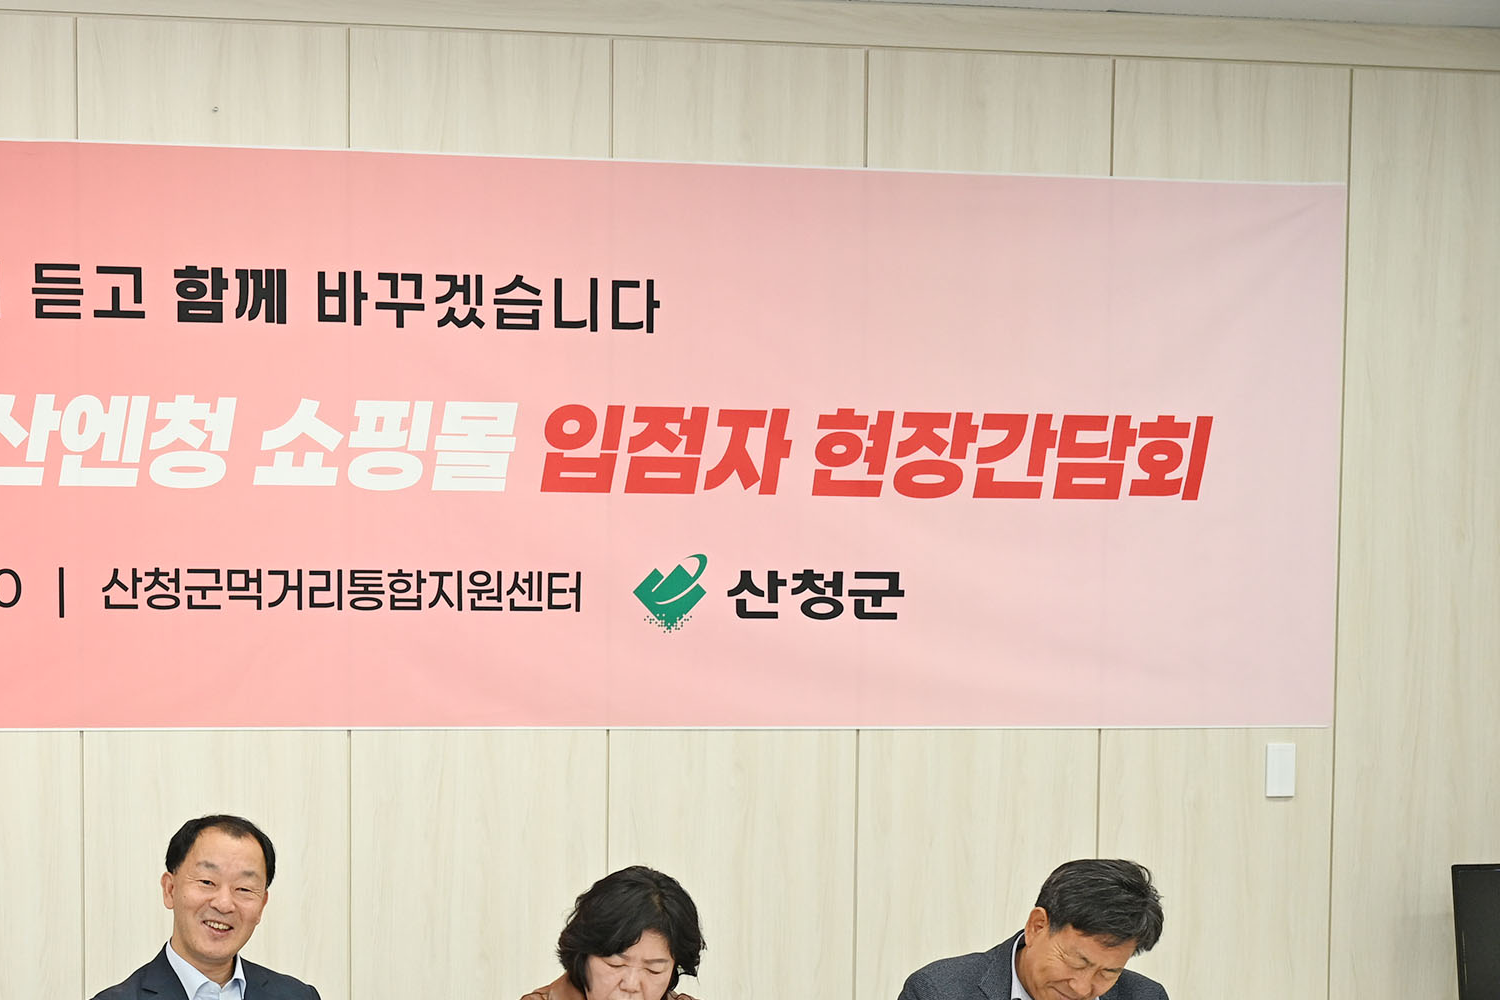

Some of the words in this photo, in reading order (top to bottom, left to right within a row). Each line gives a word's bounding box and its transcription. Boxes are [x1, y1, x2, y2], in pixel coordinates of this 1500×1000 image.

[33, 264, 146, 320] 듣고
[175, 266, 288, 325] 함께
[318, 271, 661, 335] 바꾸겠습니다
[254, 399, 519, 492] 쇼핑몰
[540, 404, 793, 496] 입점자
[812, 408, 1214, 502] 현장간담회
[102, 566, 583, 614] 산청군먹거리통합지원센터
[727, 569, 907, 621] 산청군
